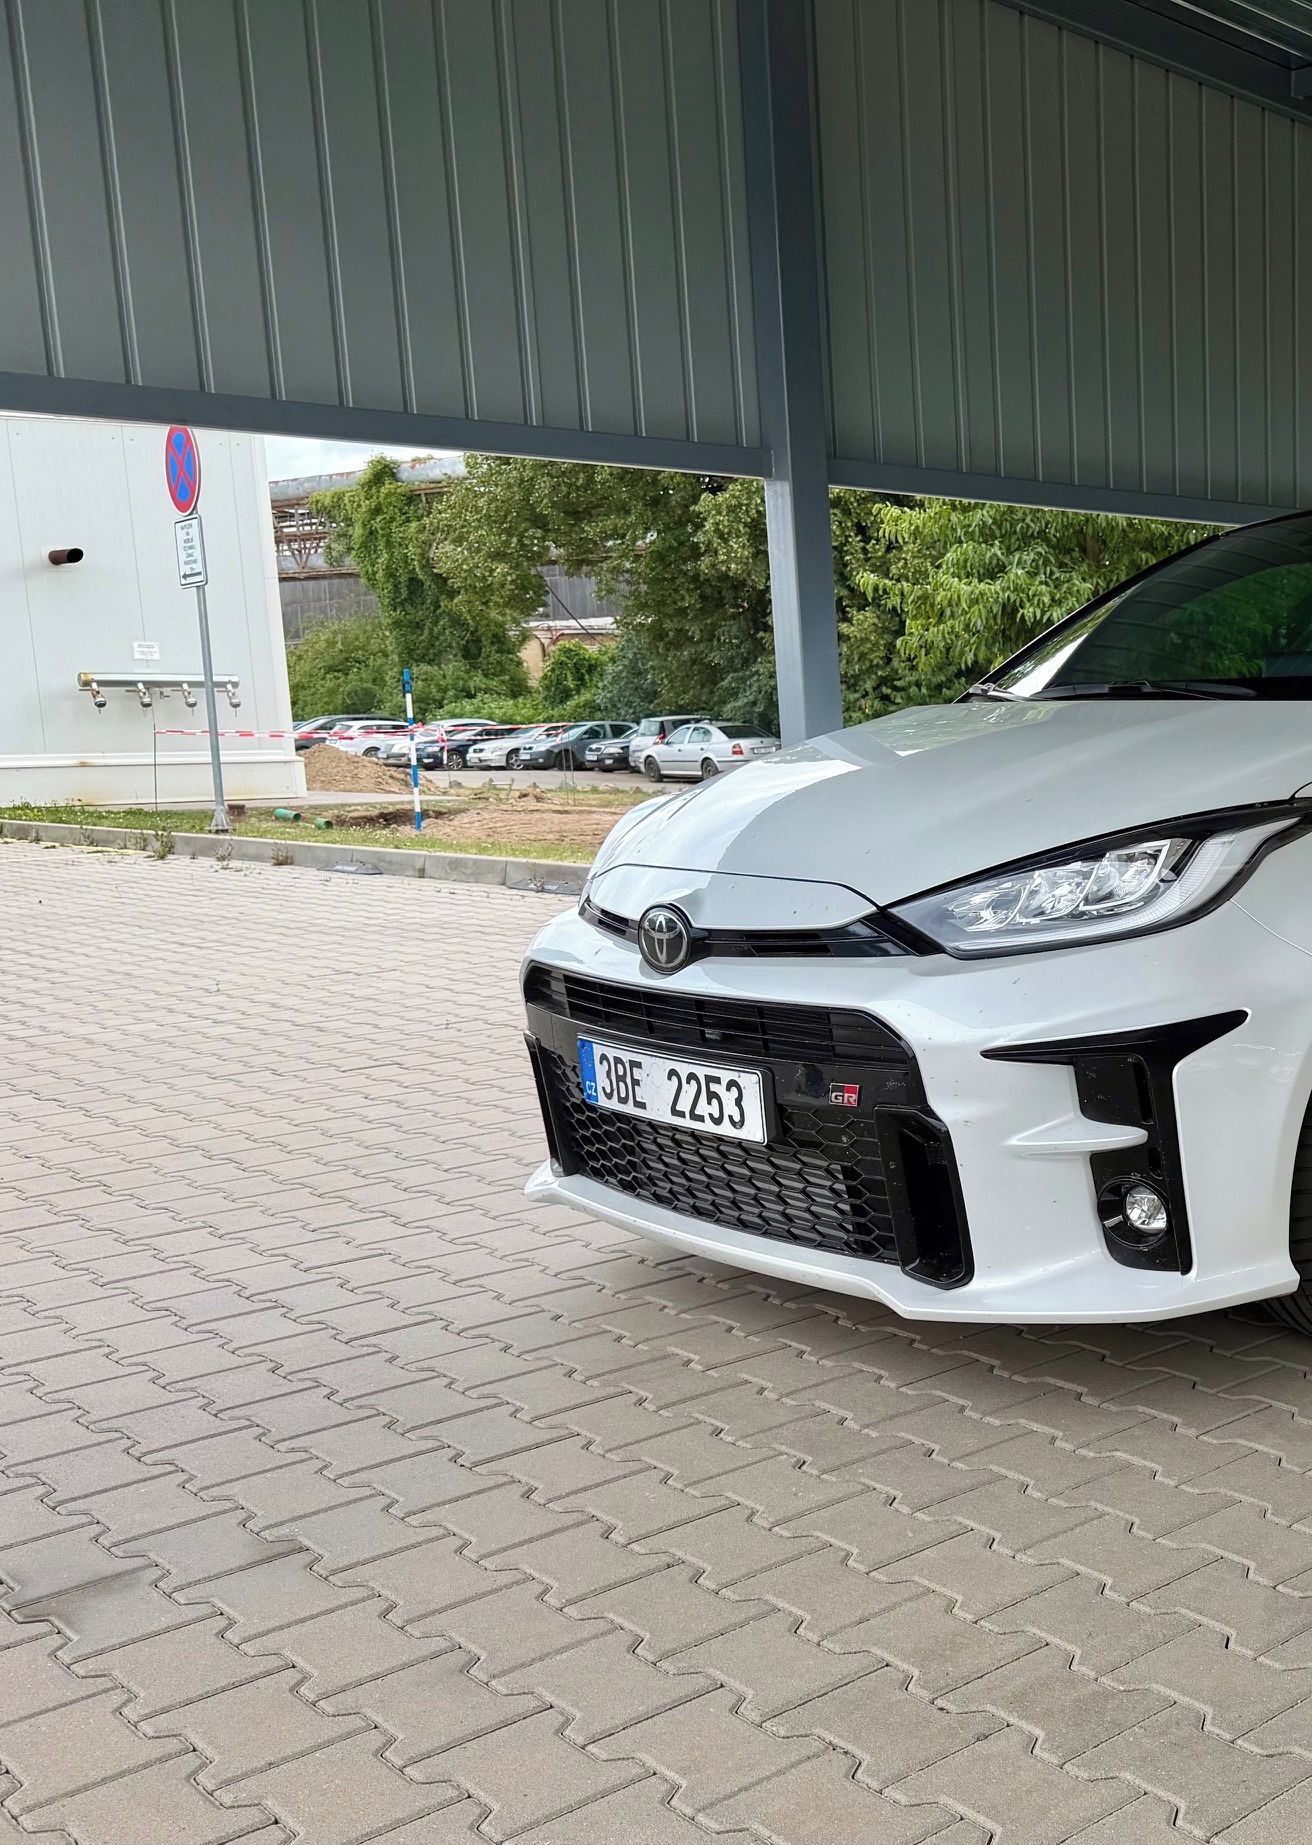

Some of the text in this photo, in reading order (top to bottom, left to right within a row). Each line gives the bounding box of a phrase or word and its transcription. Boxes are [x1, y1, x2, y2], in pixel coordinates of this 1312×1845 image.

[586, 1080, 597, 1096] CZ
[599, 1053, 745, 1130] 3BE 2253
[831, 1092, 857, 1105] GR
